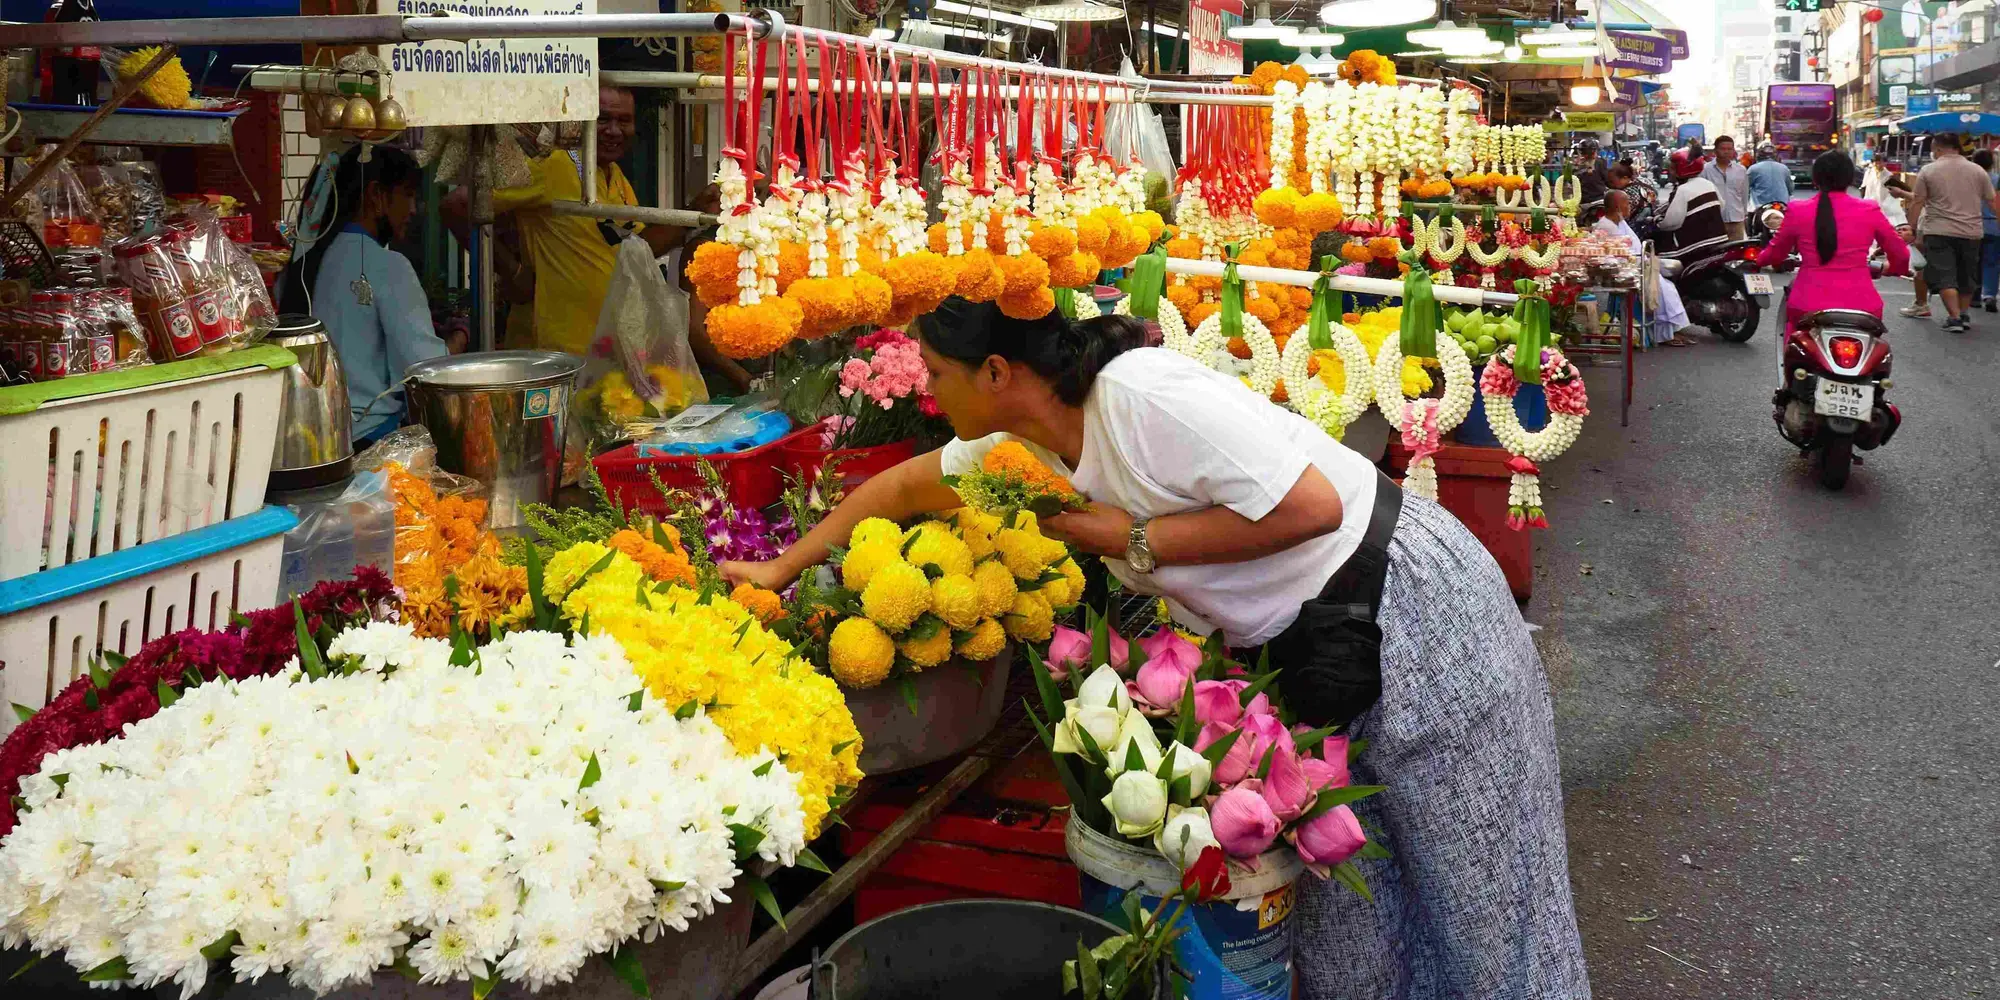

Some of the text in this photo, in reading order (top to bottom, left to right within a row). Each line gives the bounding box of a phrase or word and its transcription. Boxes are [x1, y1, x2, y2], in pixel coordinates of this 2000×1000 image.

[1828, 403, 1859, 416] 225
[1222, 941, 1235, 949] The
[1235, 938, 1256, 947] lasting
